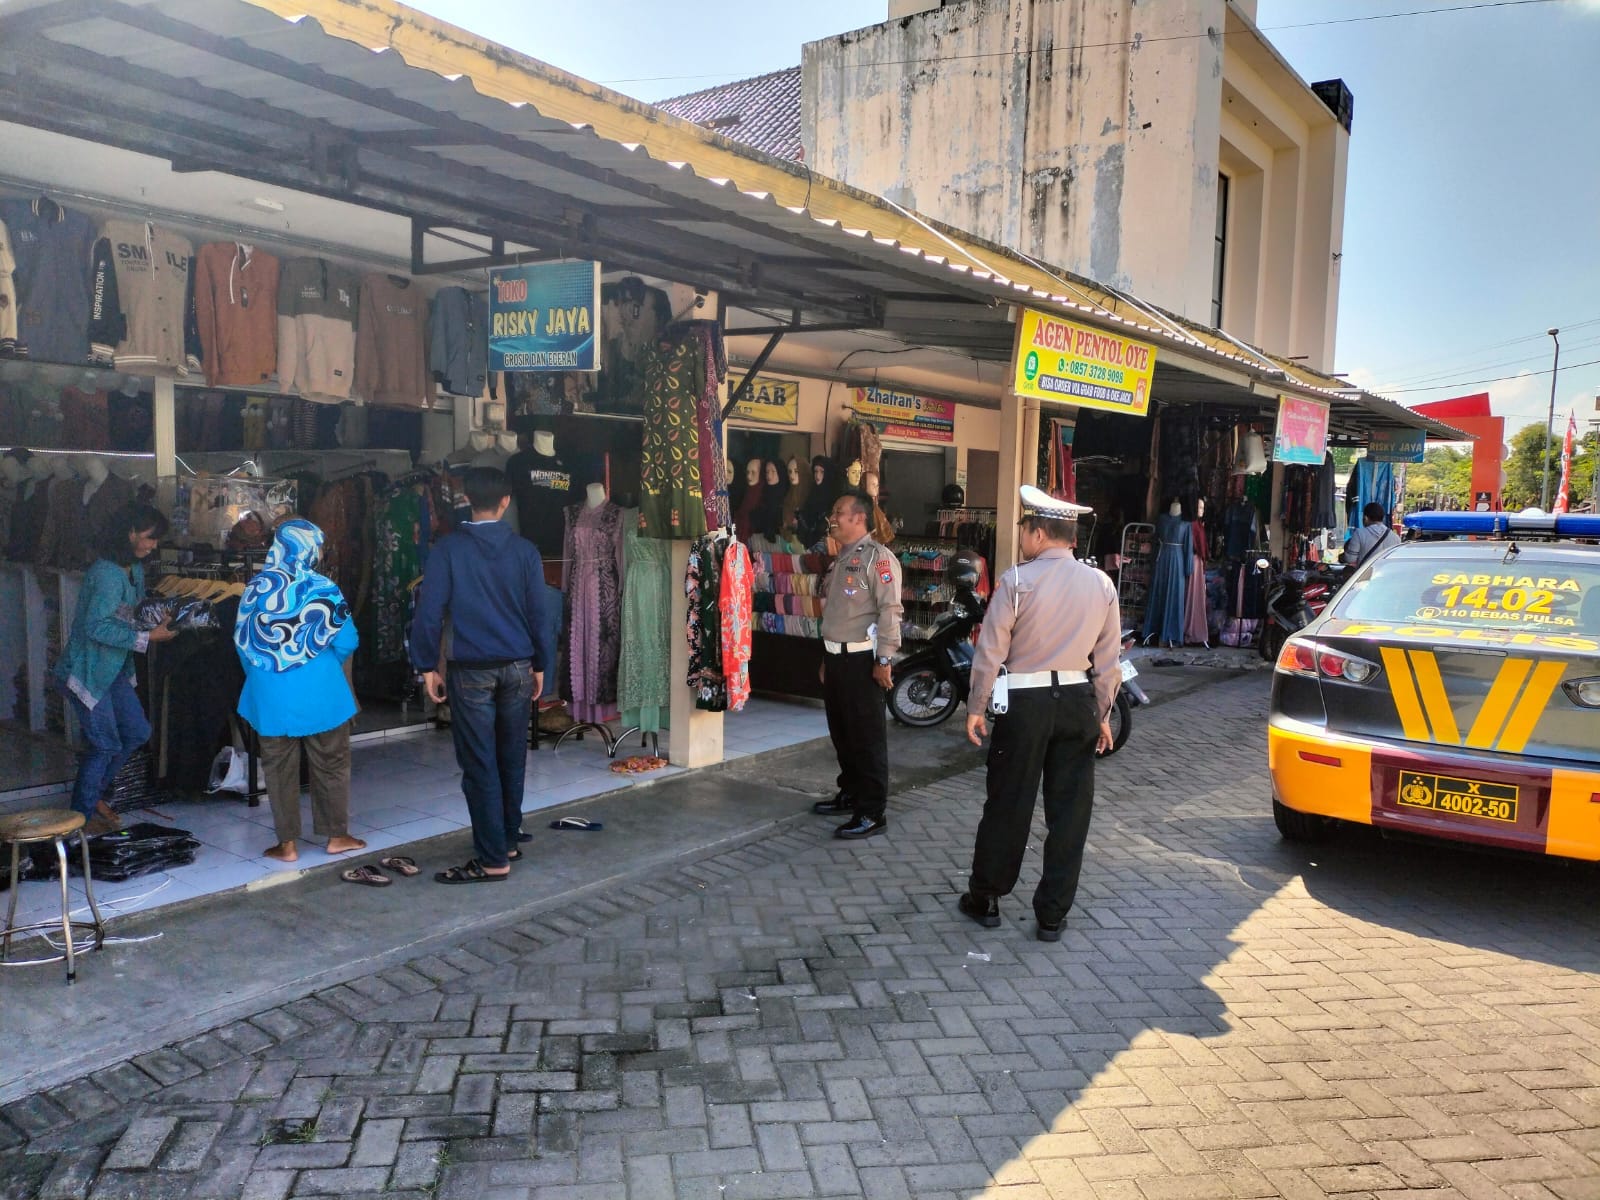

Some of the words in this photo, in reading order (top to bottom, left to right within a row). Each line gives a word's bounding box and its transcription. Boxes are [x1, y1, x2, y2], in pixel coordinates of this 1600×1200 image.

[118, 242, 147, 260] SM
[93, 272, 105, 320] INSPIRATION
[498, 280, 527, 303] TOKO
[493, 309, 538, 337] RISKY
[545, 306, 591, 336] JAYA
[1032, 318, 1074, 352] AGEN
[1075, 330, 1123, 365] PENTOL
[1126, 345, 1149, 370] OYE
[504, 352, 530, 367] GROSIR
[531, 352, 546, 367] DAN
[548, 351, 577, 366] ECERAN
[1070, 361, 1088, 376] 0857
[1089, 364, 1106, 380] 3728
[1042, 376, 1054, 389] BISA
[1054, 378, 1071, 392] ORDER
[1072, 381, 1080, 394] VIA
[1080, 383, 1093, 396] GRAB
[1094, 385, 1106, 398] FOOD
[1399, 443, 1422, 452] JAYA
[1432, 572, 1582, 592] SABHARA
[1442, 586, 1555, 614] 14.02
[1470, 611, 1520, 620] BEBAS
[1523, 614, 1575, 626] PULSA
[1468, 782, 1480, 794] X
[1441, 794, 1509, 819] 4002-50
